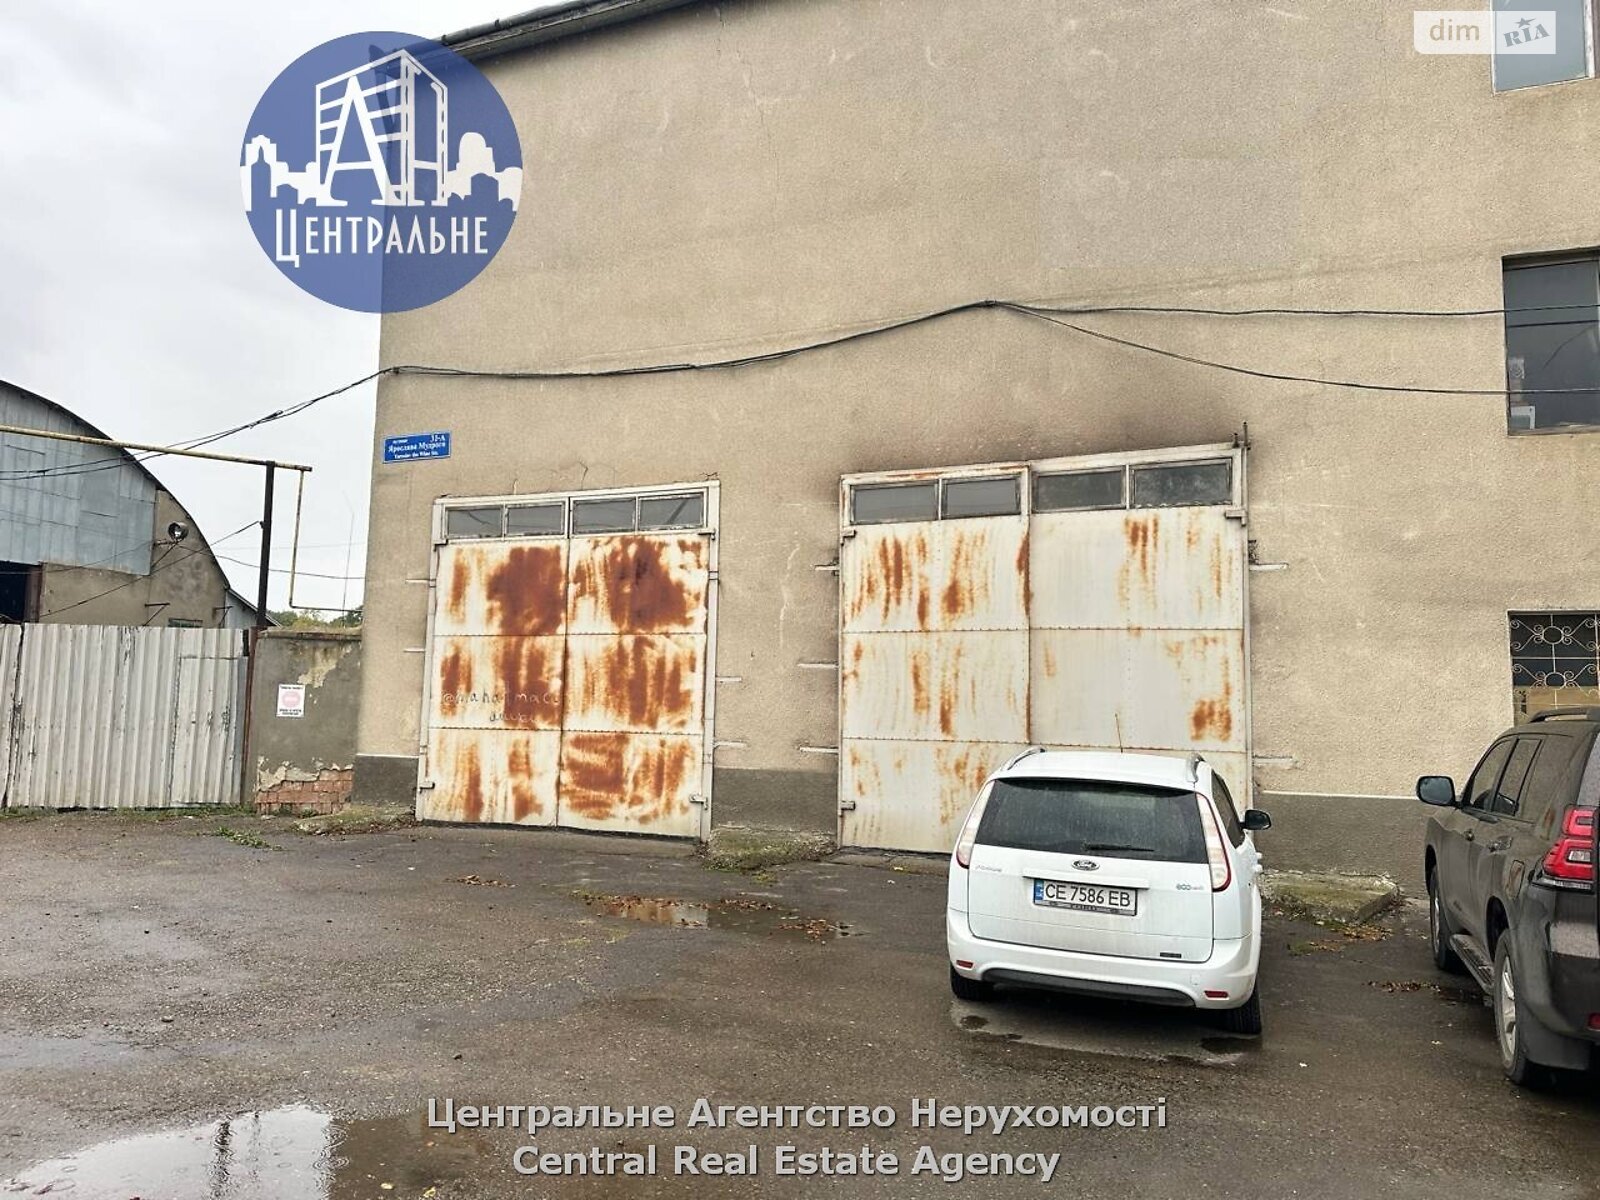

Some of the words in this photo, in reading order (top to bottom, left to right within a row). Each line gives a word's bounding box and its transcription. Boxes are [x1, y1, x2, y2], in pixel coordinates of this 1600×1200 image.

[1045, 883, 1067, 900] CE
[1070, 886, 1105, 904] 7586
[1109, 890, 1131, 907] EB
